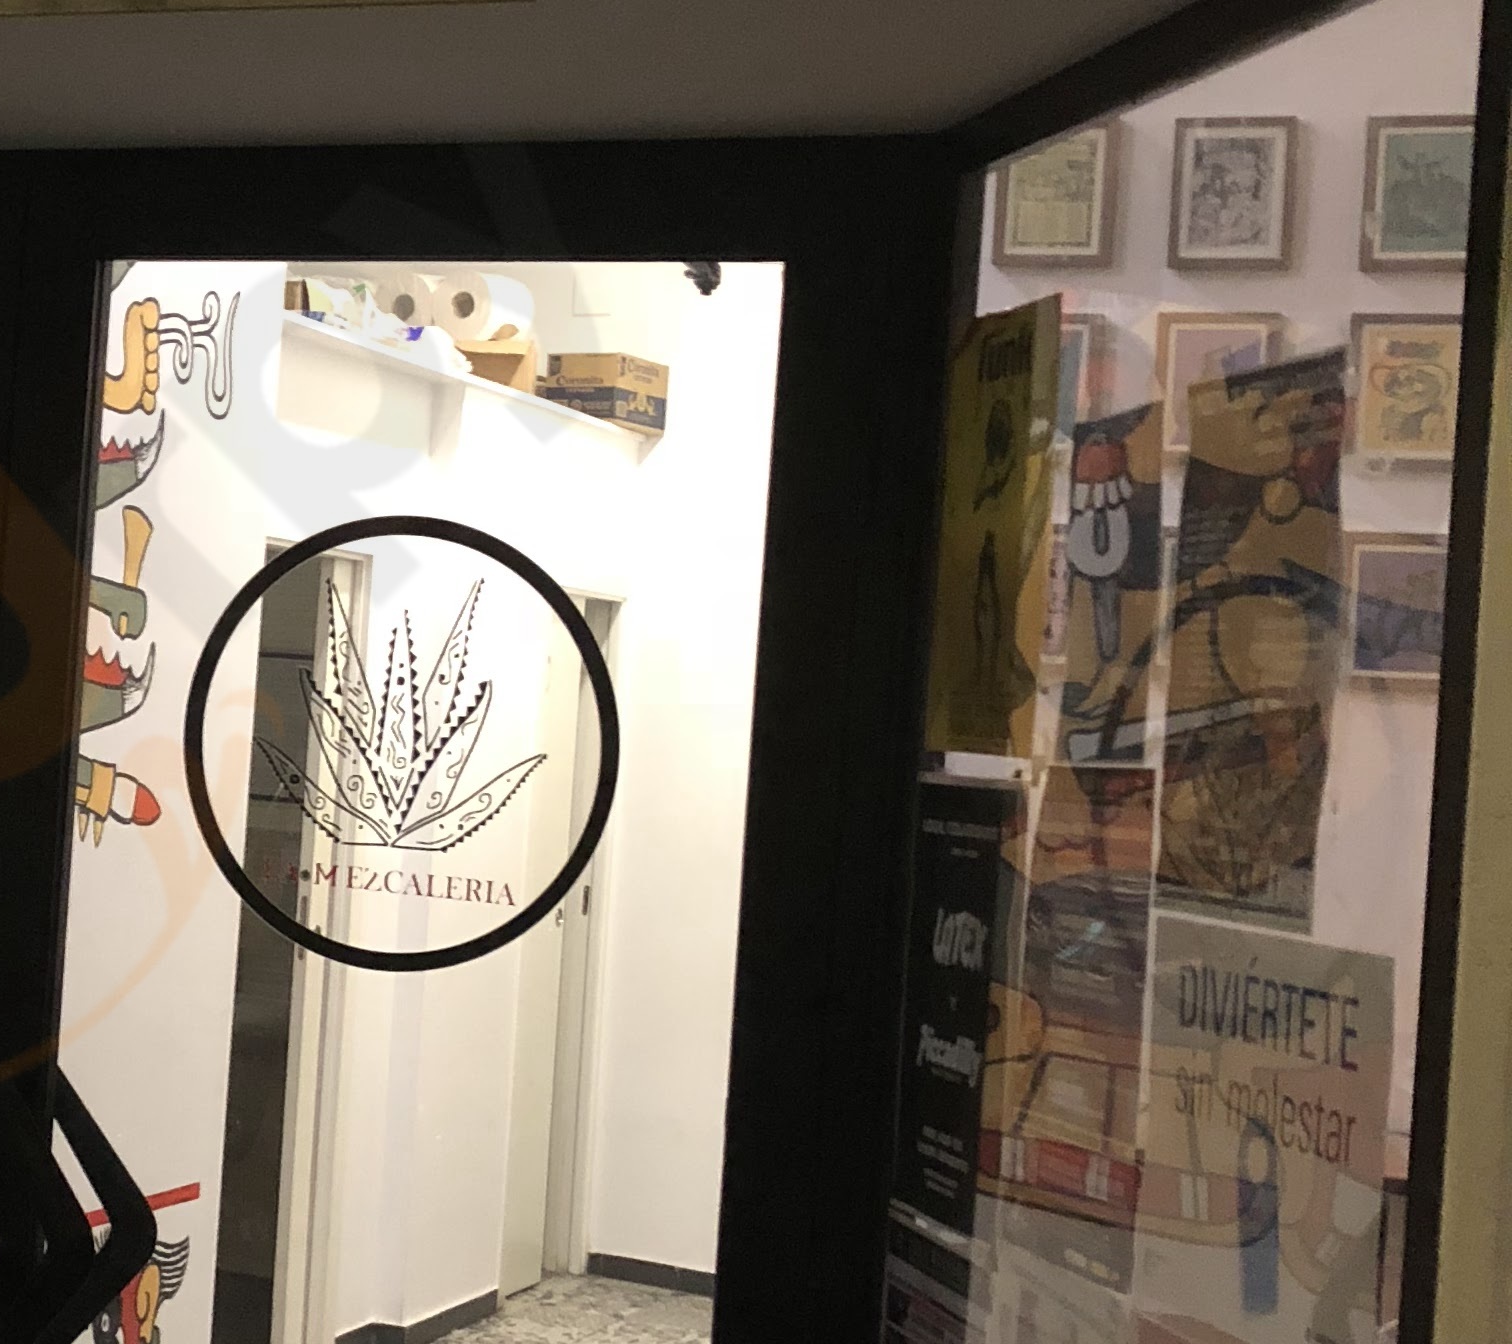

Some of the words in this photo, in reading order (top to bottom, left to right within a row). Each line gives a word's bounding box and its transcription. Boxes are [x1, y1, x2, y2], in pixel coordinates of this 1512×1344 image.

[313, 861, 516, 906] MEZCALERIA
[1179, 955, 1360, 1072] DIVIÉRTETE
[1227, 1072, 1357, 1168] molestar
